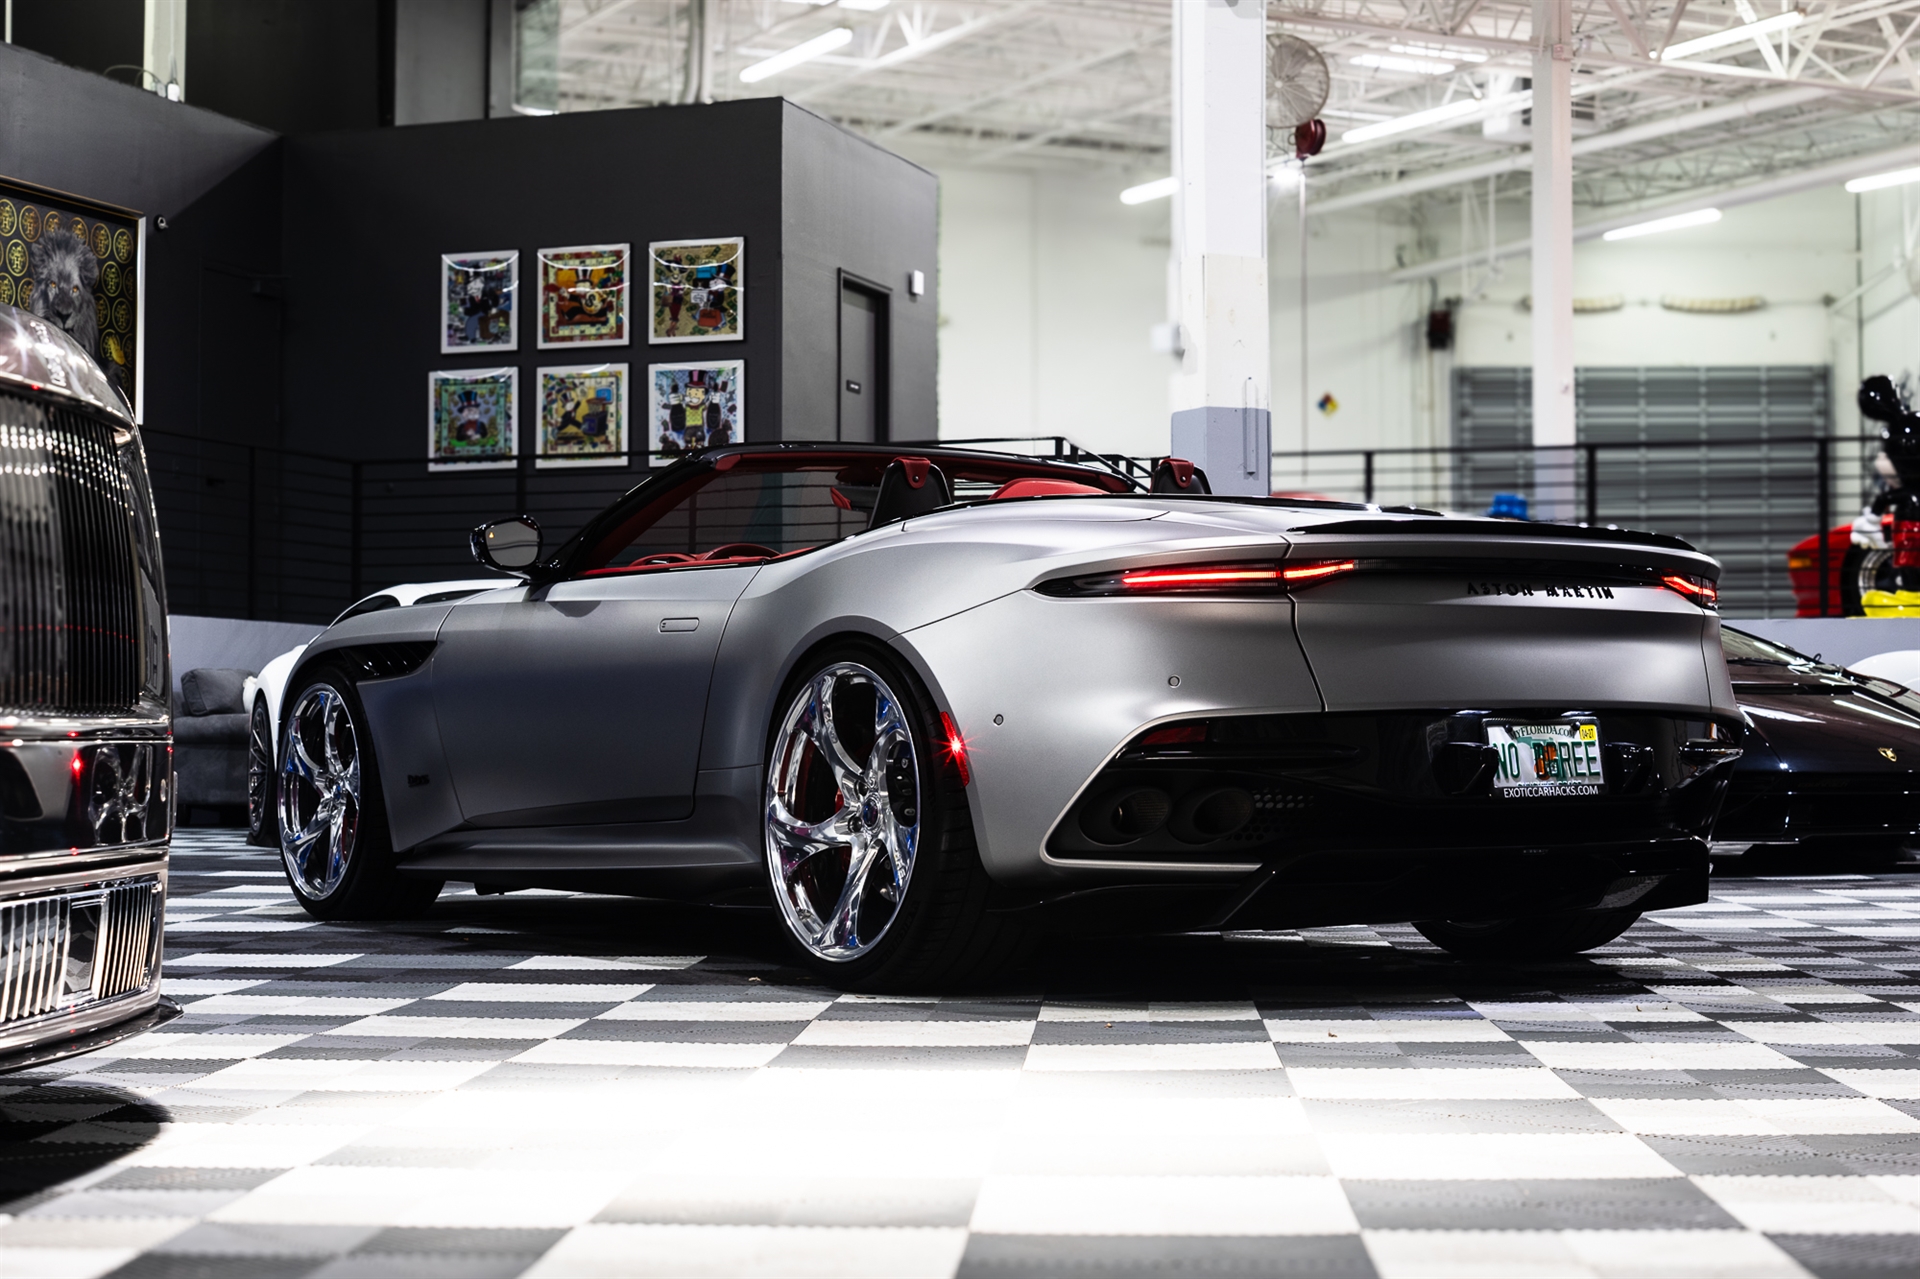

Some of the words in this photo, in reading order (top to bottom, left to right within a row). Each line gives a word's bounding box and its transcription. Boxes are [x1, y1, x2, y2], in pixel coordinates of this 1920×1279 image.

[1467, 582, 1534, 596] ASTON
[1545, 584, 1615, 599] MARTIN
[1493, 742, 1519, 779] NO
[1503, 785, 1599, 798] EXOTICCARHACKS.COM
